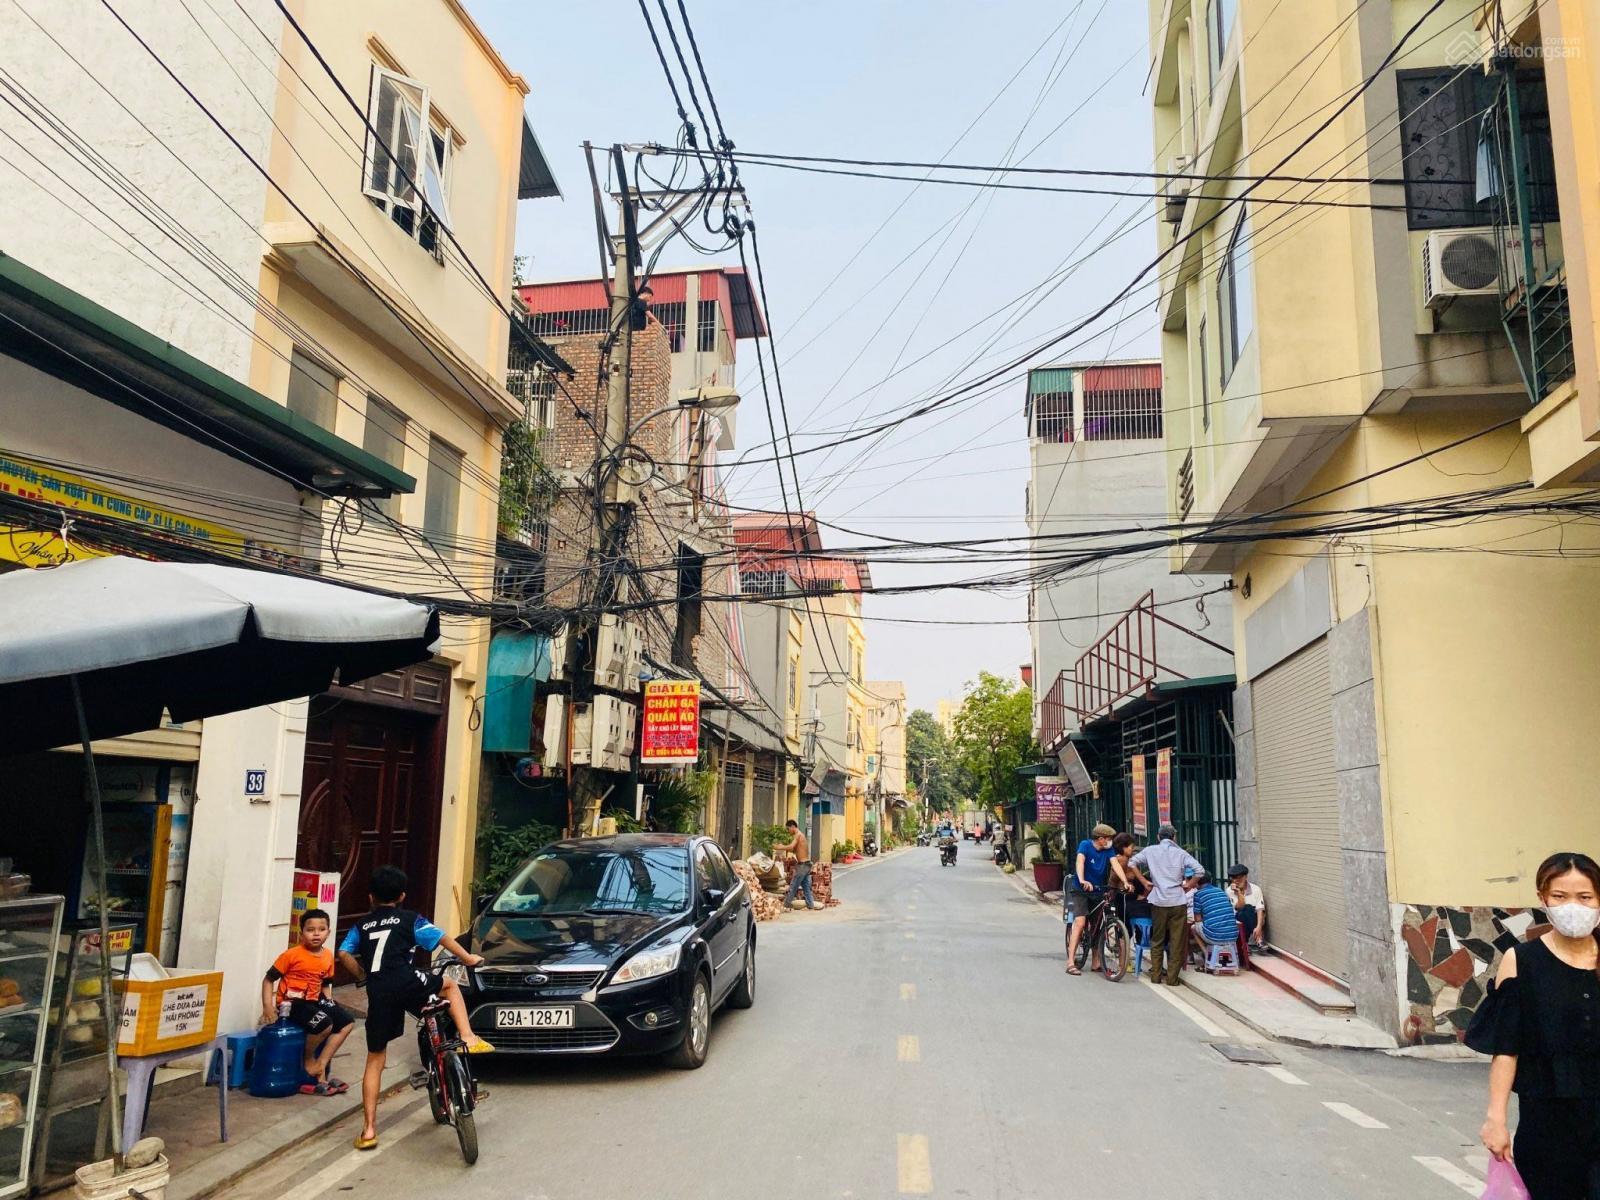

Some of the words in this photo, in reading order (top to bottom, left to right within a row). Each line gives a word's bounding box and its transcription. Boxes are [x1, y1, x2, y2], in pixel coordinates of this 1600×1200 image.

[107, 496, 132, 517] CUNG
[648, 683, 676, 694] GIẶT
[680, 697, 695, 708] GA
[248, 774, 263, 792] 33
[369, 929, 392, 973] 7
[499, 1010, 570, 1026] 29A-128.71
[176, 1022, 188, 1032] 15K
